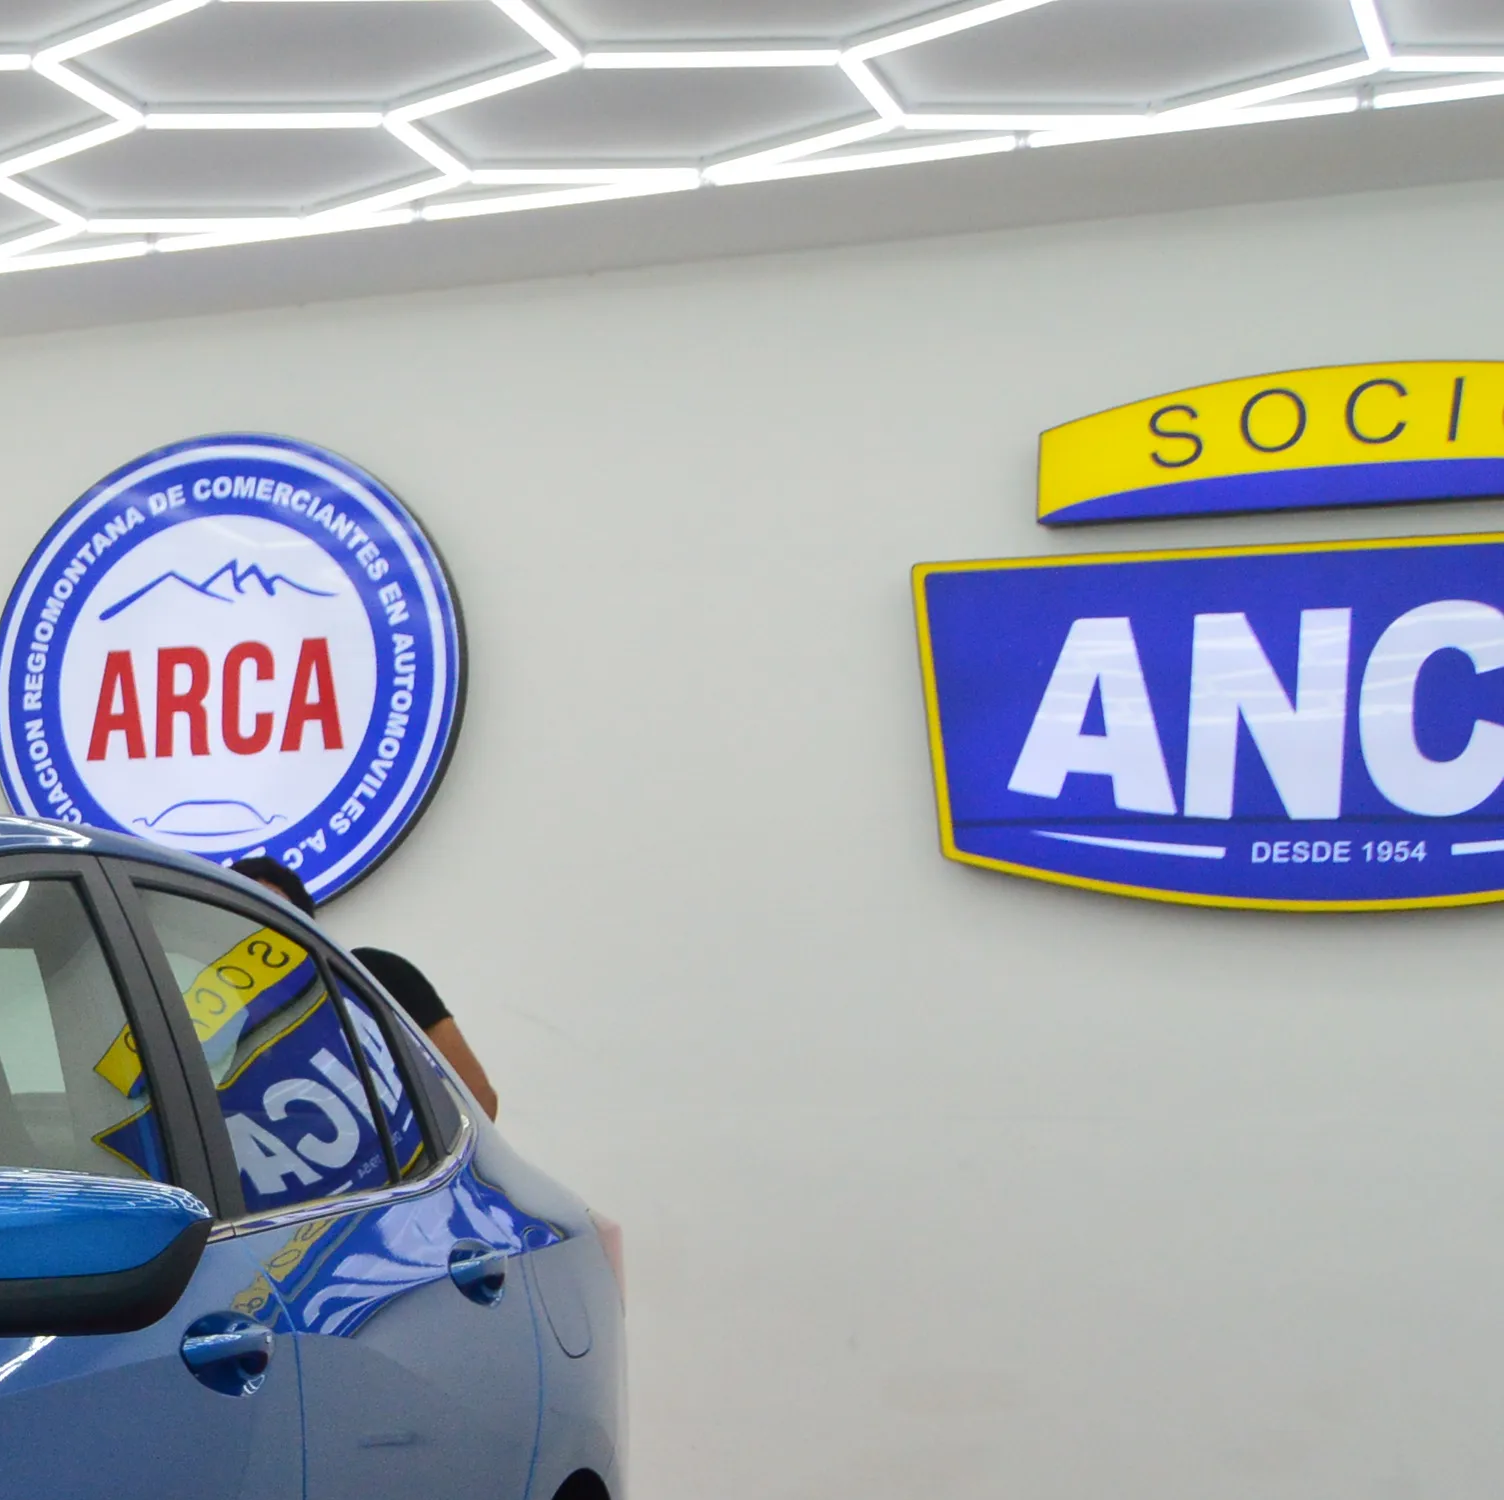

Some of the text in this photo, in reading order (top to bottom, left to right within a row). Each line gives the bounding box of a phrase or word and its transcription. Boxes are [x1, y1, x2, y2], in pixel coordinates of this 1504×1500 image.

[1149, 376, 1504, 468] SOCI
[148, 484, 186, 516] DE
[193, 476, 389, 581] COMERCIANTES
[22, 506, 146, 711] REGIOMONTANA
[378, 581, 409, 626] EN
[86, 636, 345, 761] ARCA
[329, 633, 416, 835] AUTOMOVILES
[1251, 840, 1427, 864] DESDE 1954
